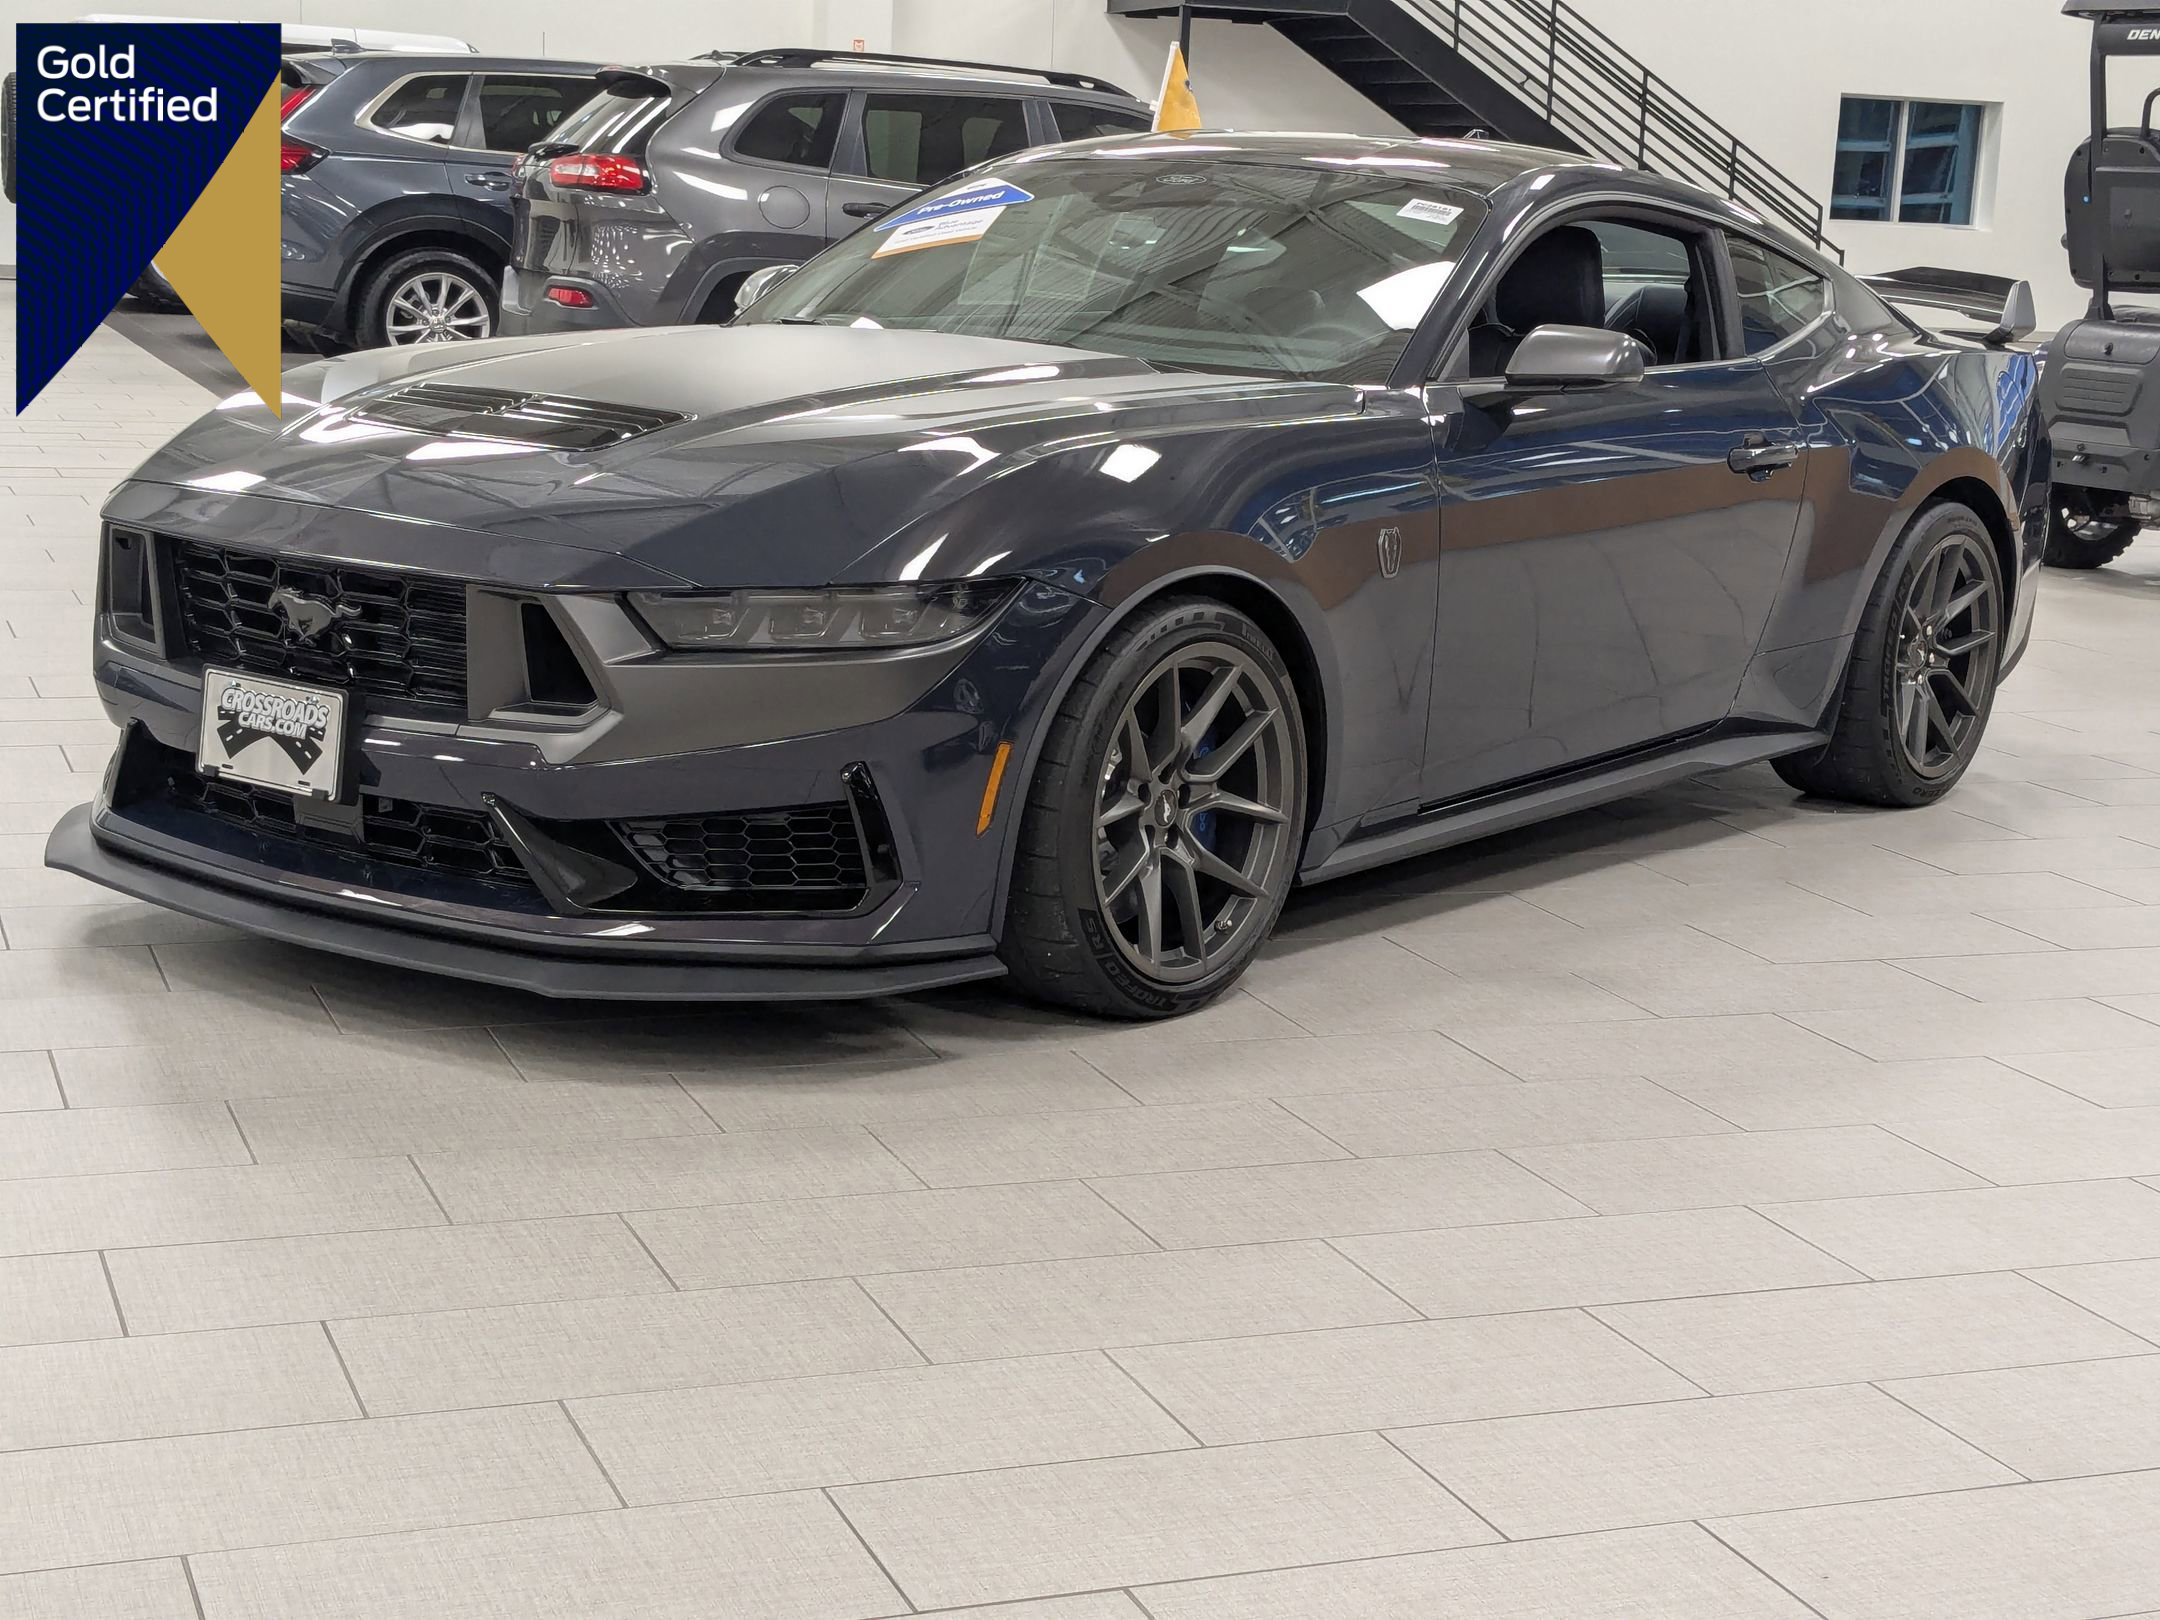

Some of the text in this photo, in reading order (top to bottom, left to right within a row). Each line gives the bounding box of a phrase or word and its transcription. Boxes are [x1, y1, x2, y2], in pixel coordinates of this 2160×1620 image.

[916, 190, 1006, 215] Pre-Owned
[220, 687, 331, 729] CROSSROADS
[237, 711, 309, 740] CARS.COM
